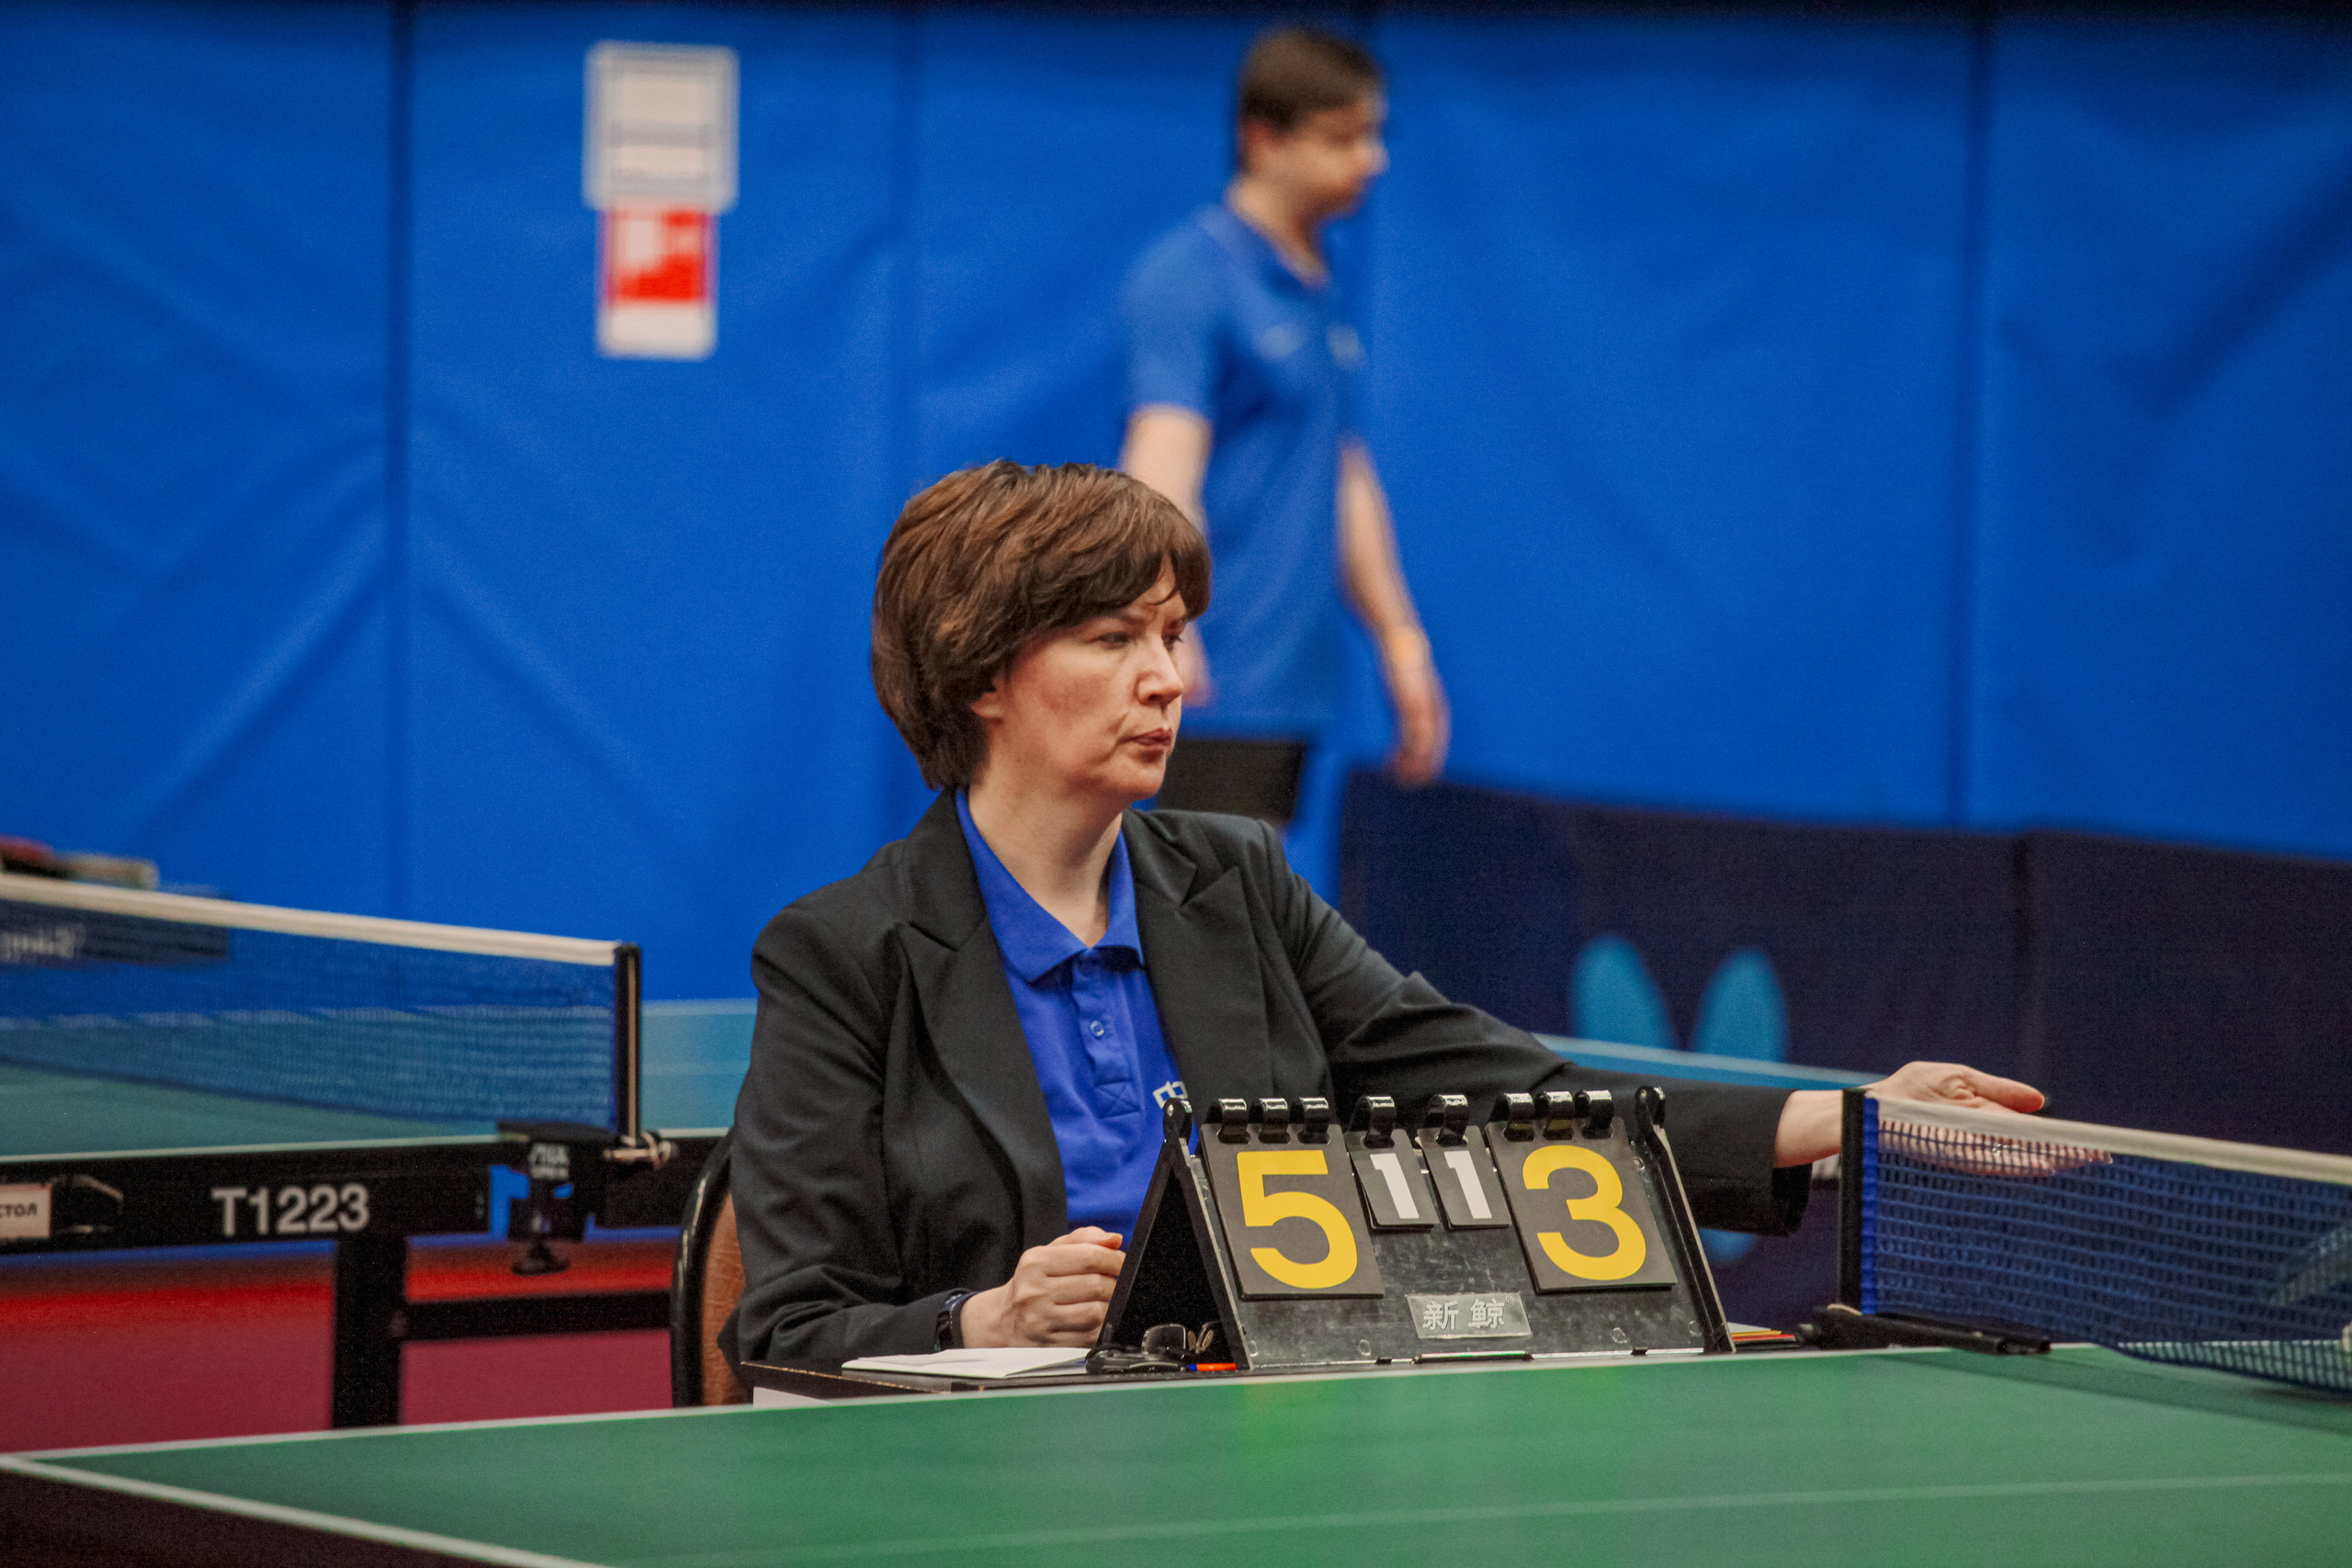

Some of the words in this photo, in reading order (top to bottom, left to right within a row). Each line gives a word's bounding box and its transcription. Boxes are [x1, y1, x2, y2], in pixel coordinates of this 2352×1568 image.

[211, 1183, 369, 1236] T1223
[1237, 1149, 1358, 1289] 5
[1370, 1154, 1419, 1219] 1
[1443, 1151, 1492, 1219] 1
[1522, 1145, 1646, 1280] 3
